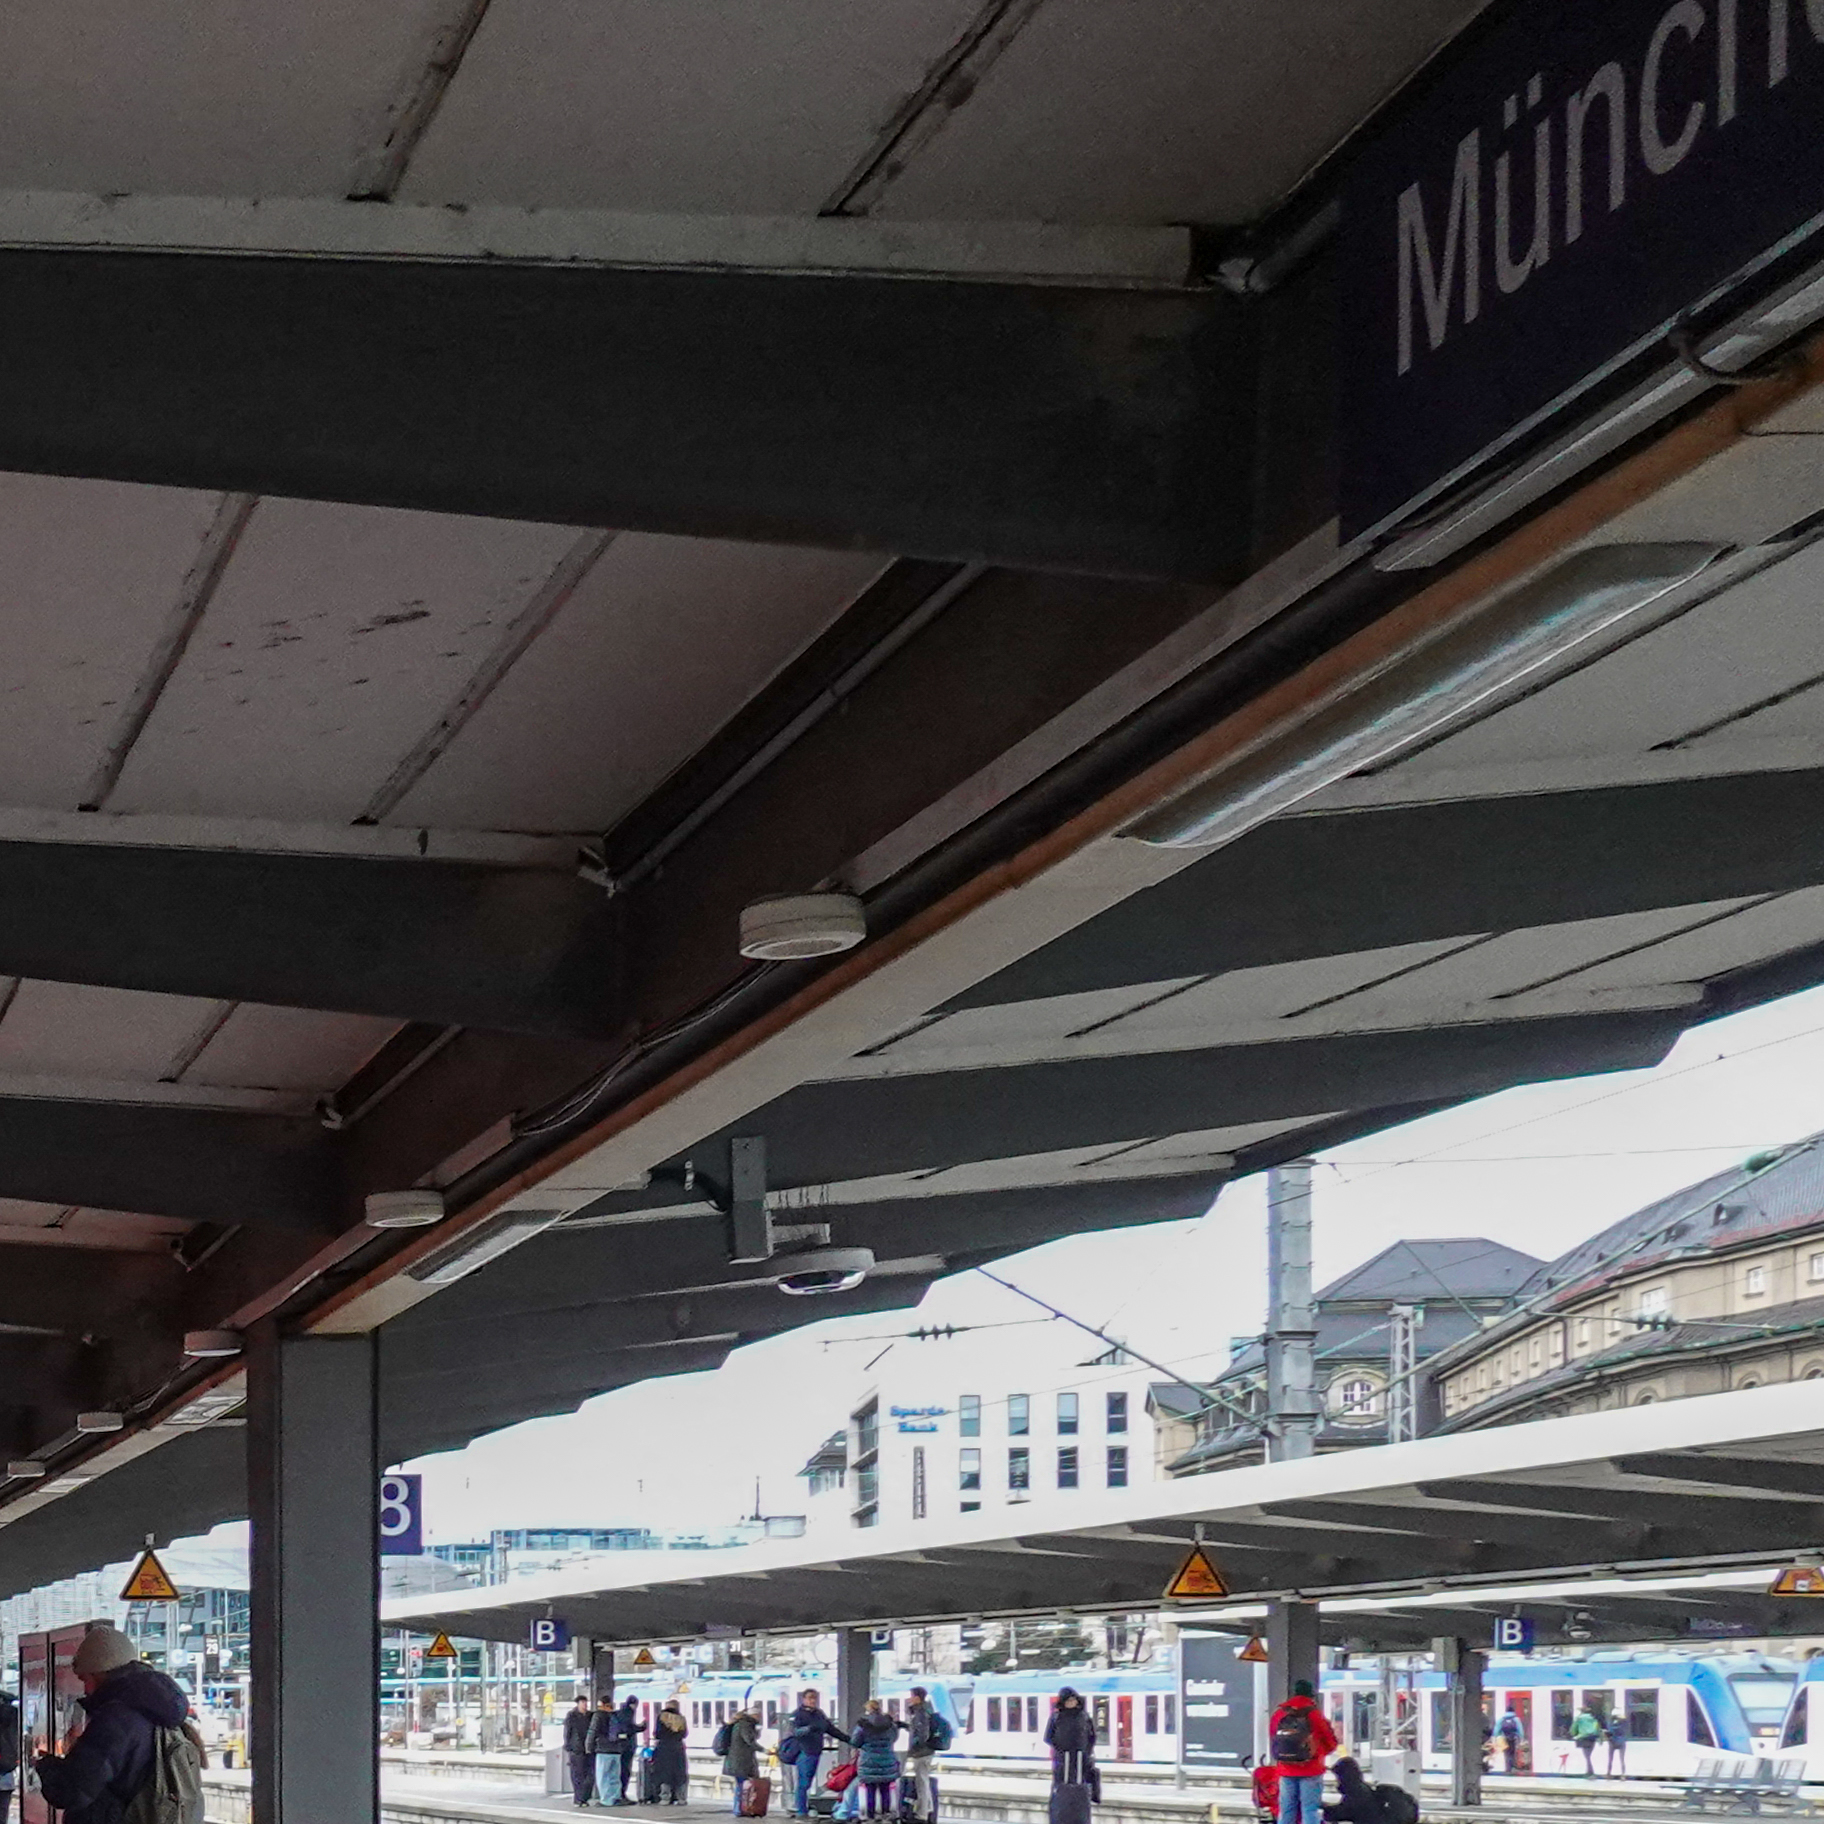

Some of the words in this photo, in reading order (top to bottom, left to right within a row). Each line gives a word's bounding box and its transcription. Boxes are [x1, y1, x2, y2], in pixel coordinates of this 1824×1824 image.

[381, 1476, 411, 1536] 8
[536, 1620, 556, 1645] B
[1503, 1618, 1523, 1645] B
[206, 1643, 219, 1655] 29
